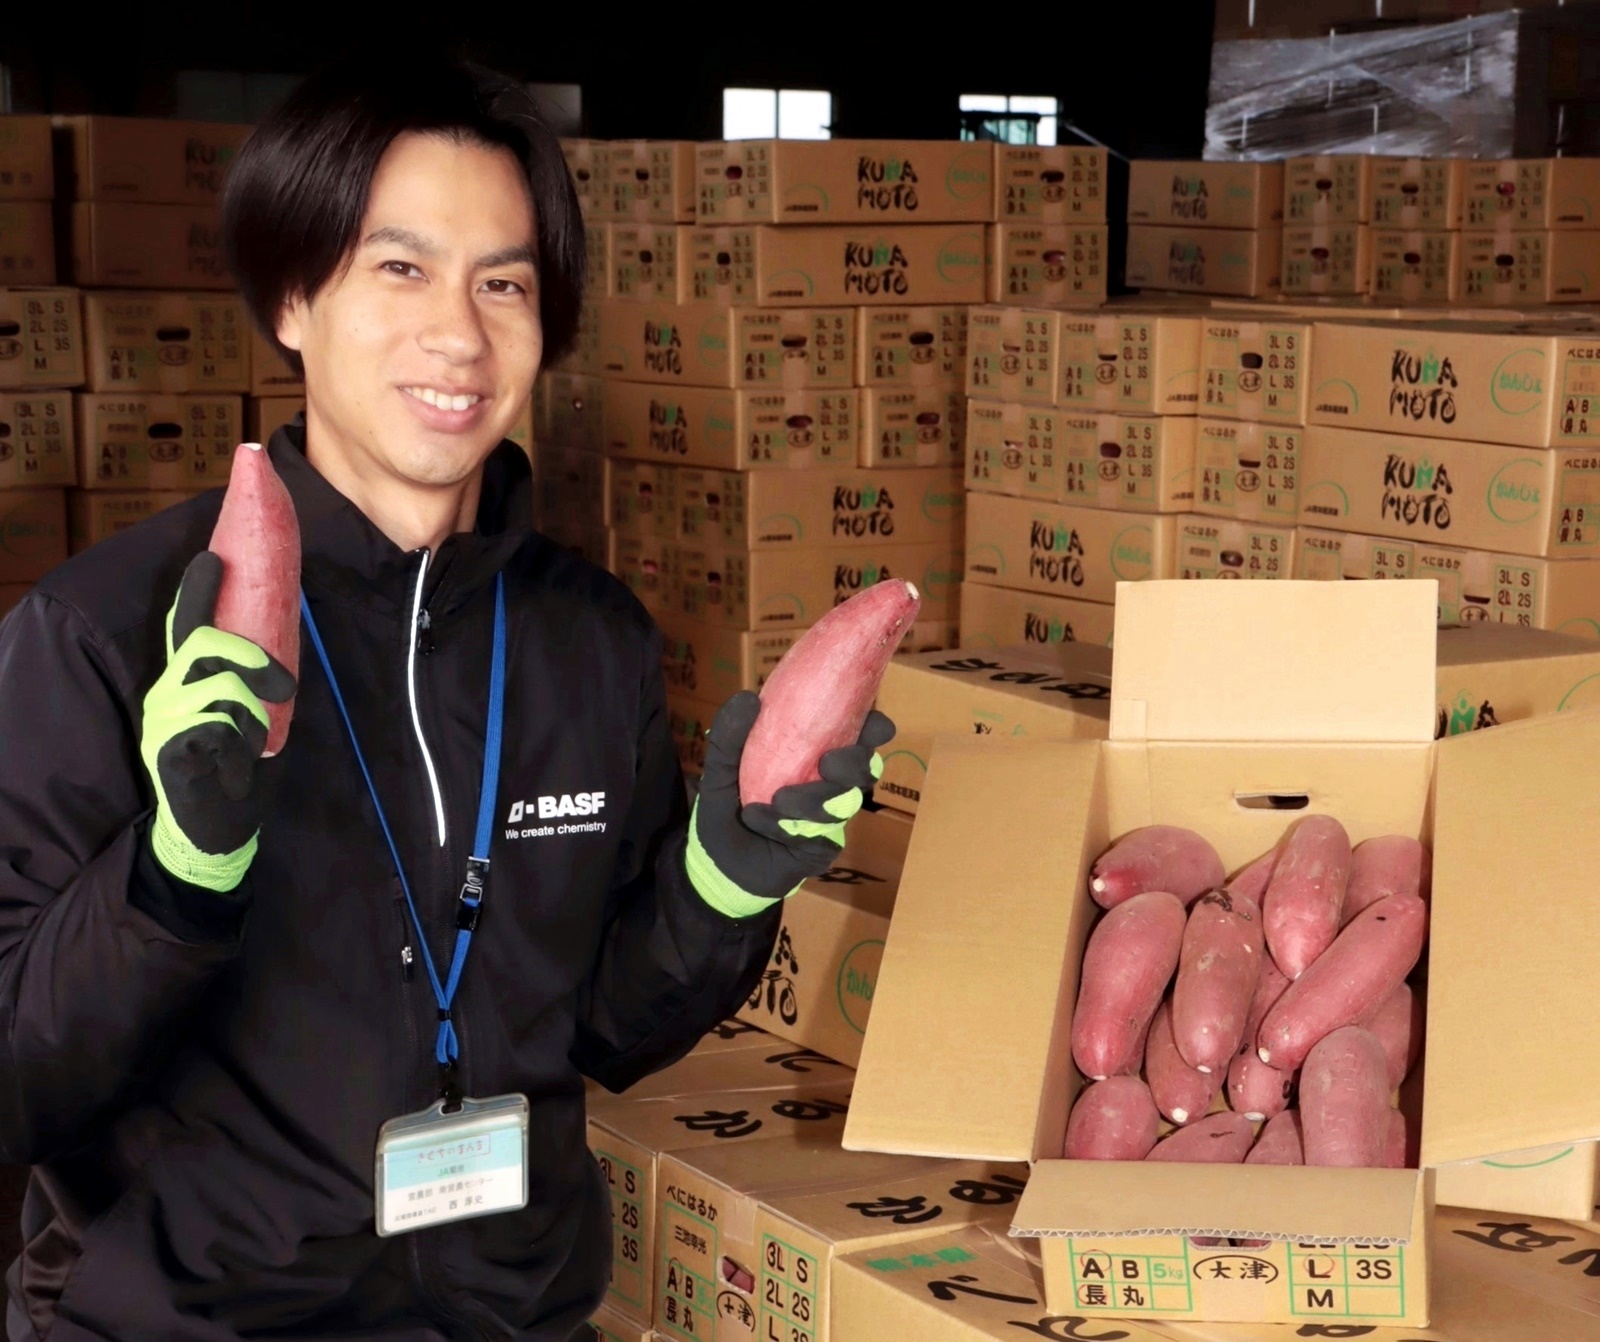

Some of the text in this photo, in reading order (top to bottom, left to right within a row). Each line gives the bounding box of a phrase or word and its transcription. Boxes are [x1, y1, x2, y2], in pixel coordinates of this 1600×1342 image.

[857, 154, 918, 183] KUMA
[858, 183, 919, 211] MOTO
[844, 238, 908, 268] KUMA
[844, 268, 909, 296] MOTO
[54, 300, 65, 314] S
[30, 318, 69, 333] 2L 2S
[1139, 328, 1148, 341] S
[34, 337, 70, 351] L 3S
[1269, 335, 1295, 350] 3L S
[34, 357, 47, 370] M
[1284, 356, 1296, 370] 2S
[1391, 346, 1458, 388] KUMA
[1066, 367, 1074, 379] A
[1124, 366, 1131, 379] L
[1207, 372, 1214, 384] A
[1269, 375, 1295, 389] L 3S
[1123, 385, 1132, 397] M
[1268, 394, 1277, 406] M
[1389, 384, 1457, 424] MOTO
[1565, 399, 1589, 414] A B
[45, 402, 56, 417] S
[21, 421, 60, 436] 2L 2S
[1127, 426, 1152, 440] 3L S
[25, 441, 36, 454] L
[1268, 436, 1294, 451] 3L S
[1141, 445, 1153, 459] 2S
[25, 459, 38, 472] M
[1067, 462, 1074, 474] A
[1128, 464, 1135, 476] L
[1283, 456, 1295, 470] 2S
[1565, 459, 1600, 469] べにはる
[1203, 470, 1210, 484] A
[1383, 453, 1453, 495] KUMA
[1127, 482, 1136, 494] M
[1268, 475, 1295, 489] L 3S
[833, 484, 894, 511] KUMA
[1267, 494, 1276, 507] M
[1381, 488, 1451, 530] MOTO
[1562, 508, 1584, 523] A B
[833, 510, 895, 537] MOTO
[1030, 518, 1085, 557] KUMA
[1183, 526, 1219, 537] べにはるか
[1251, 537, 1278, 552] 3L S
[1304, 538, 1342, 551] べにはるか
[1249, 556, 1278, 571] 2L 2S
[1376, 551, 1404, 568] 3L S
[1421, 556, 1461, 570] べにはるか
[1030, 551, 1085, 587] MOTO
[1498, 569, 1530, 587] 3L S
[1497, 589, 1531, 608] 2L 2S
[537, 791, 606, 819] BASF
[505, 821, 607, 840] We create chemistry
[625, 1169, 636, 1195] S
[666, 1184, 718, 1222] べにはるか
[622, 1201, 639, 1229] 2S
[622, 1235, 639, 1262] 3S
[766, 1240, 809, 1284] 3L S
[1082, 1257, 1184, 1281] A B 5kg
[1308, 1258, 1393, 1280] L 3S
[1209, 1260, 1269, 1281] 大津
[667, 1266, 678, 1293] A
[685, 1275, 694, 1299] B
[766, 1278, 811, 1322] 2L 2S
[1086, 1285, 1145, 1307] 長 丸
[1307, 1288, 1334, 1309] M
[667, 1295, 678, 1324] 長
[683, 1305, 694, 1332] 丸
[769, 1315, 780, 1342] L
